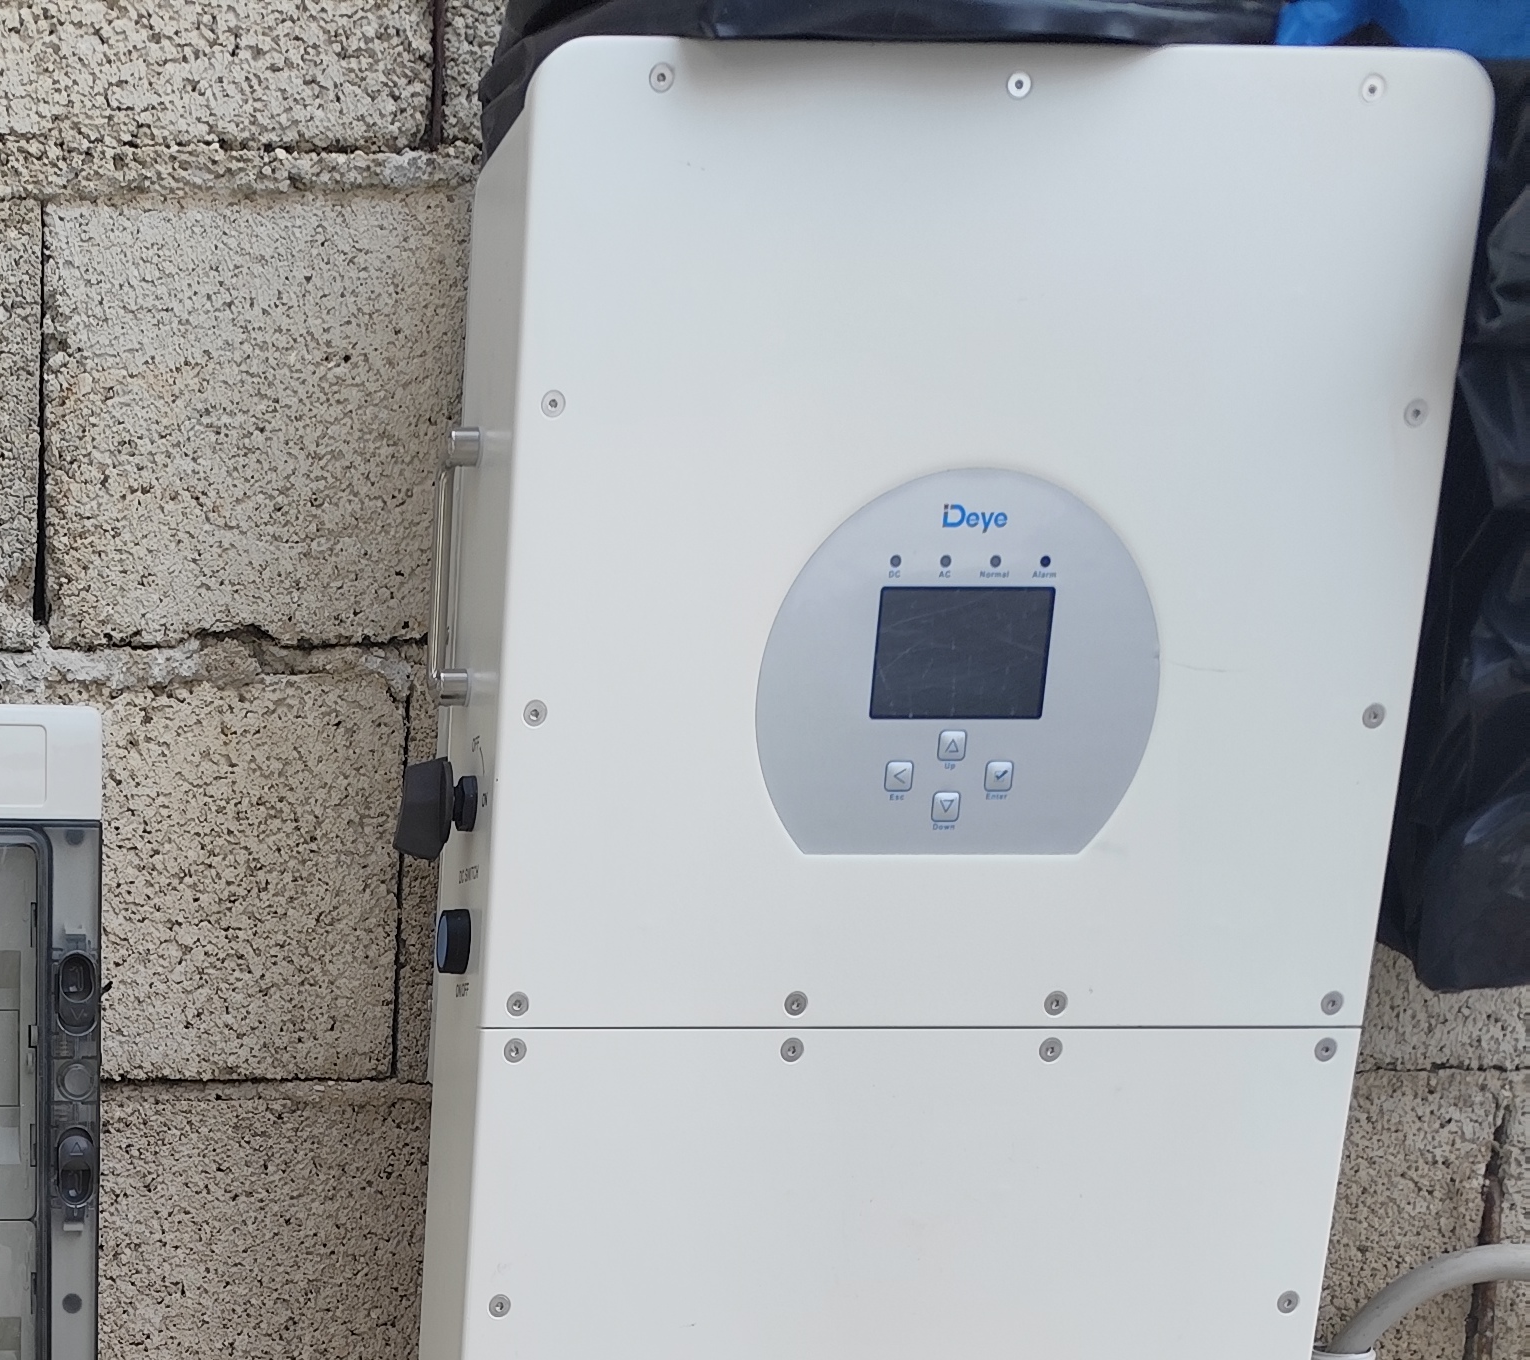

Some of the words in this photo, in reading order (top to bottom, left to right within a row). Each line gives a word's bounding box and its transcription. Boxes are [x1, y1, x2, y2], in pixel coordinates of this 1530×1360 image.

[888, 570, 902, 579] DC
[938, 570, 952, 579] AC
[979, 570, 1010, 579] Normal
[1032, 570, 1058, 579] Alarm
[944, 761, 956, 771] Up
[889, 793, 905, 802] Esc
[985, 792, 1008, 802] Enter
[932, 823, 956, 832] Down
